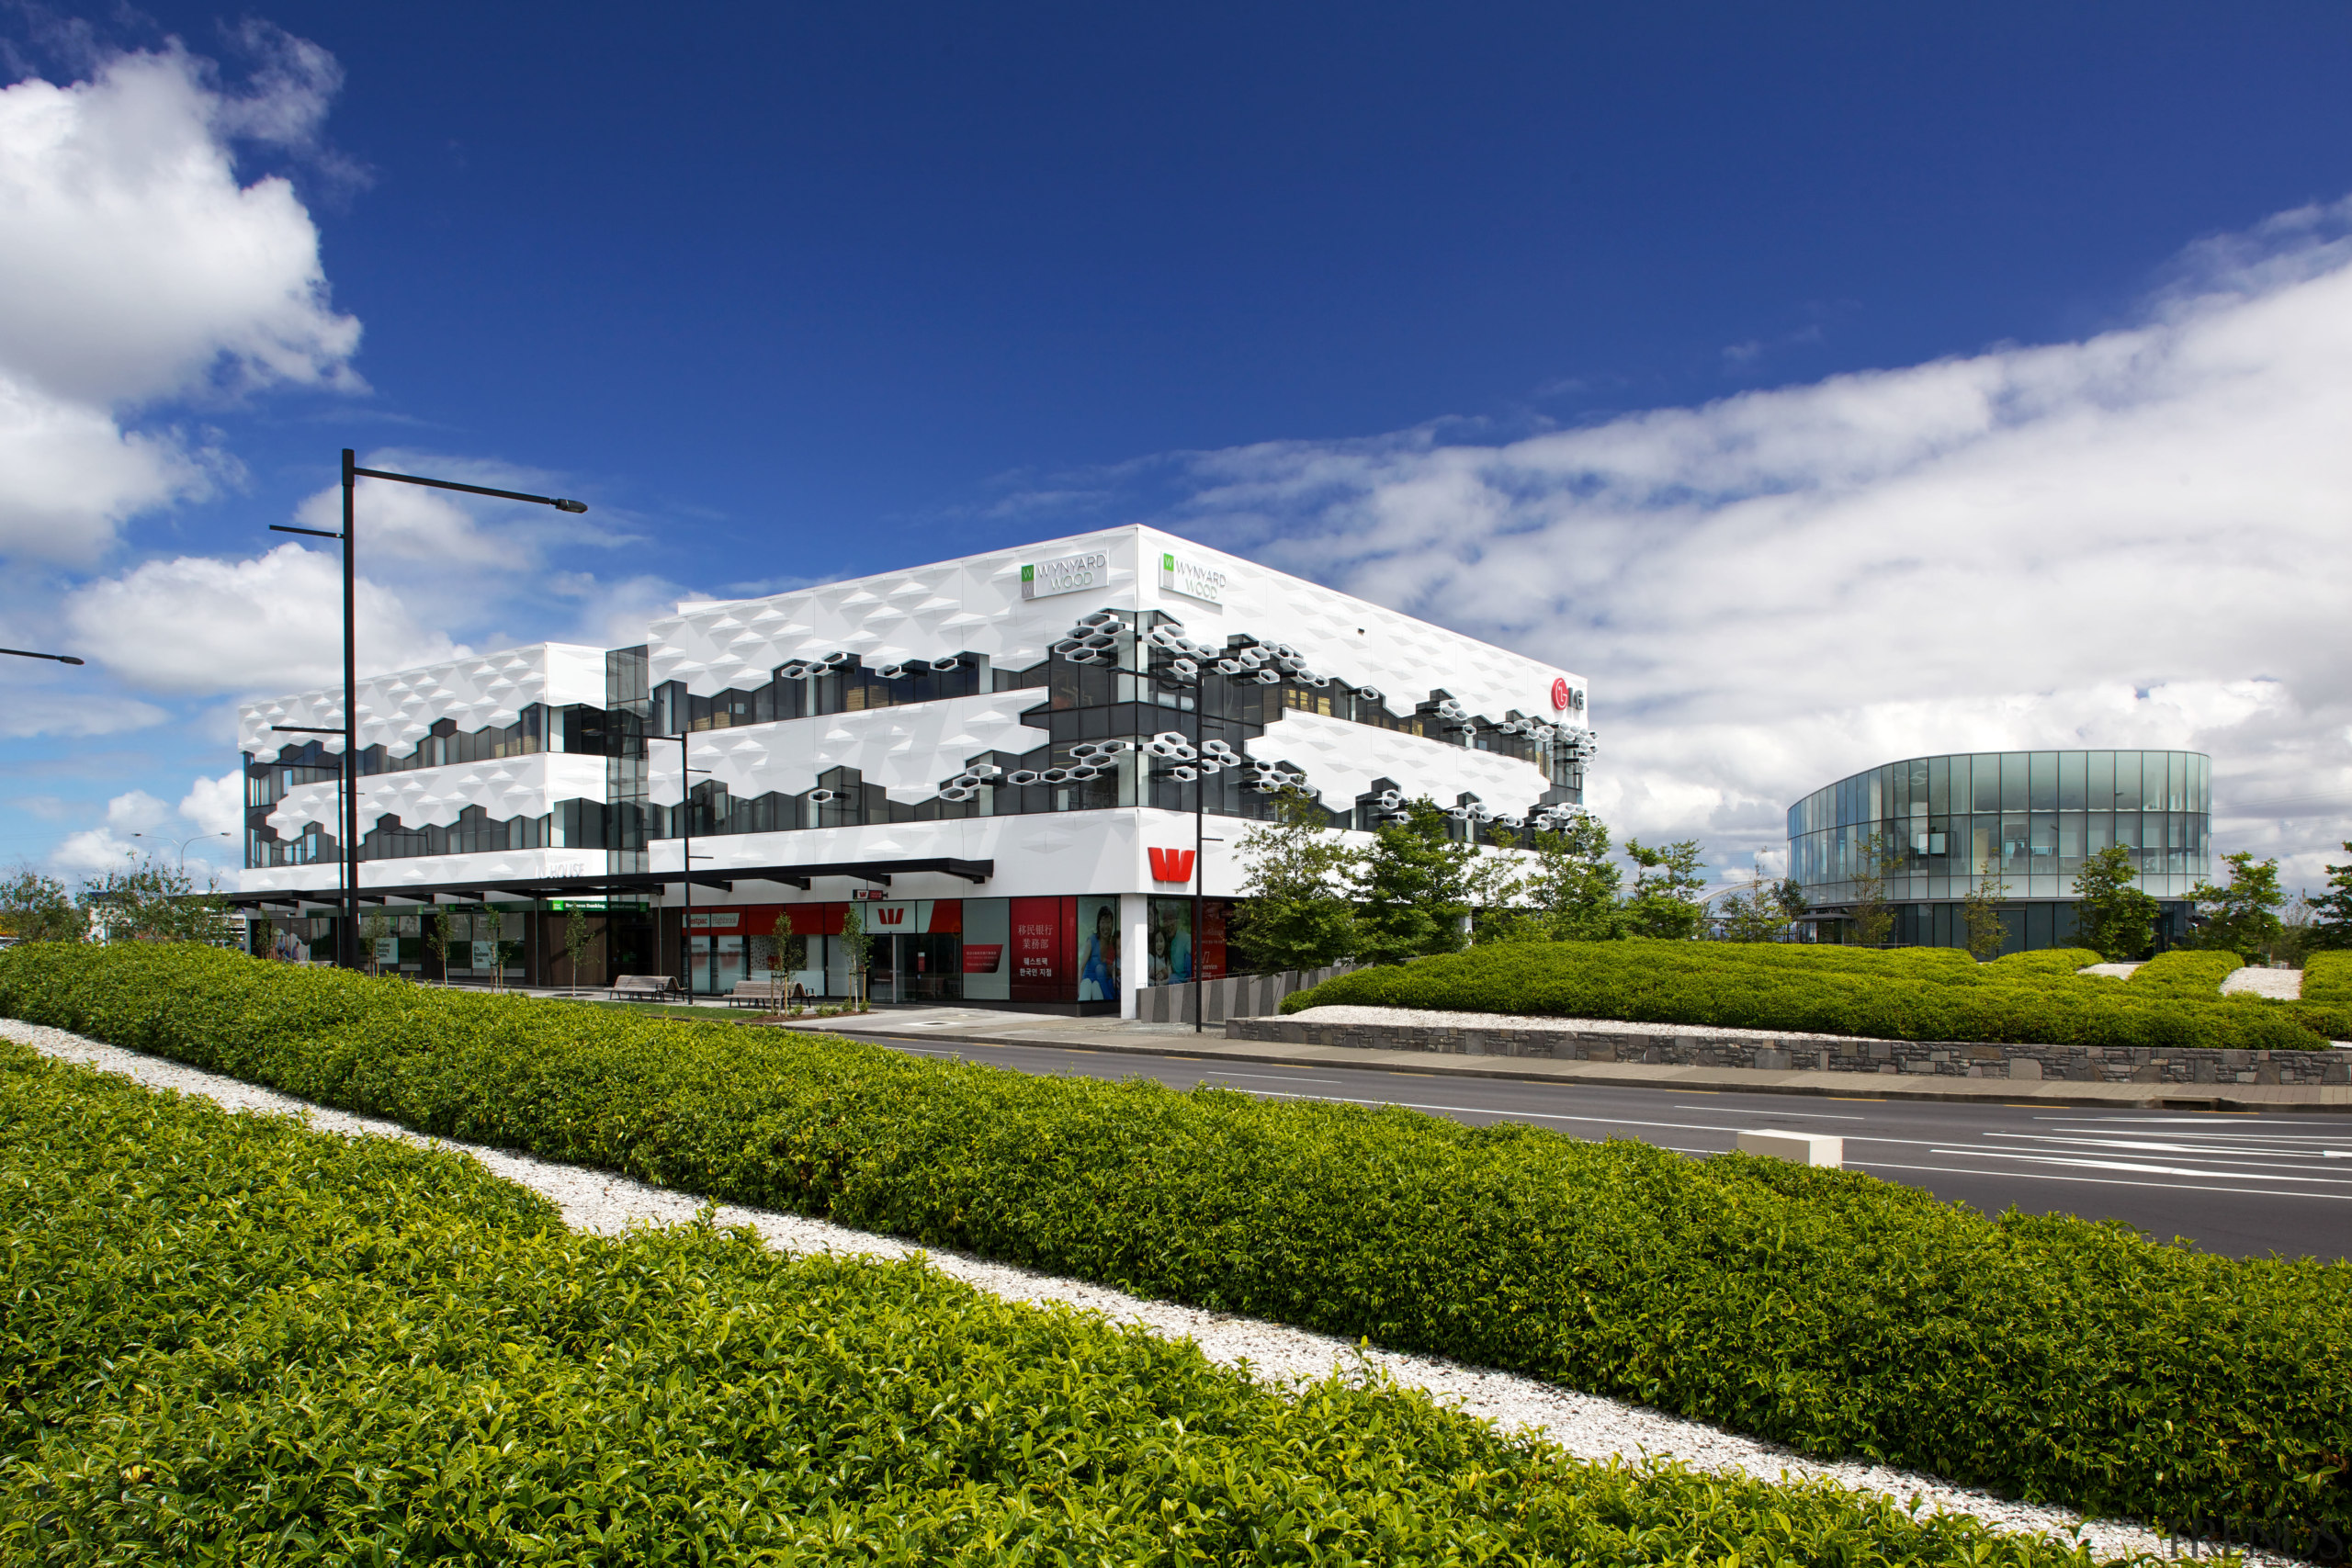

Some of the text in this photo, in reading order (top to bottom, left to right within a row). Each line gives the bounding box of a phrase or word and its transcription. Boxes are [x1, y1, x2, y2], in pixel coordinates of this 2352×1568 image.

[1037, 554, 1106, 578] WYNYARD
[1165, 557, 1173, 568] W
[1023, 569, 1033, 579] W
[1050, 571, 1093, 591] WOOD
[1176, 559, 1227, 588] WYNYARD
[1185, 578, 1218, 600] WOOD
[550, 863, 585, 877] HOUSE
[1020, 968, 1052, 976] 한국인 지점
